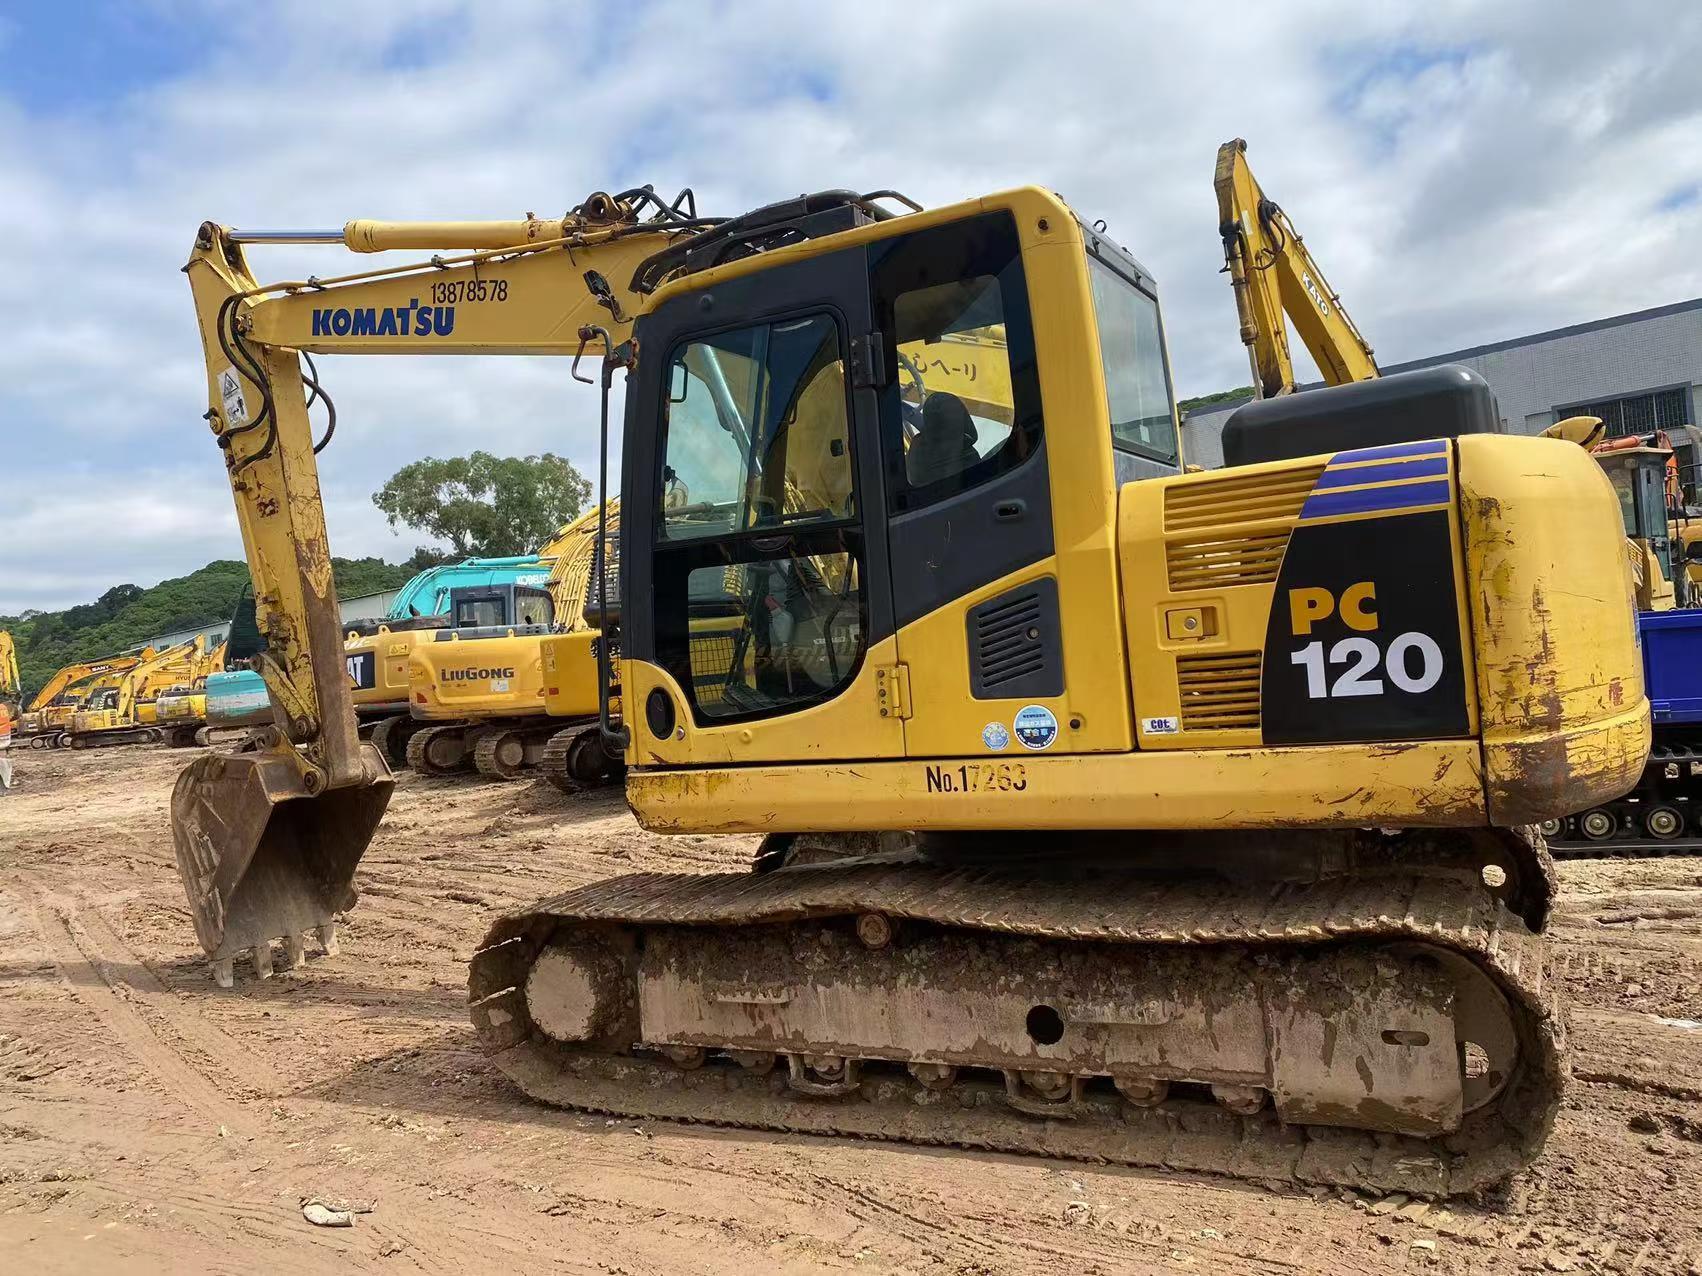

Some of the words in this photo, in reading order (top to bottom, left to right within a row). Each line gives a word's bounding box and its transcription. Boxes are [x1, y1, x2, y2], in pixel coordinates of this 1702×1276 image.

[431, 280, 508, 303] 13878578
[1302, 271, 1329, 316] KATO
[312, 298, 455, 336] KOMATSU
[1289, 582, 1378, 635] PC
[346, 656, 364, 687] AT
[1291, 631, 1443, 698] 120
